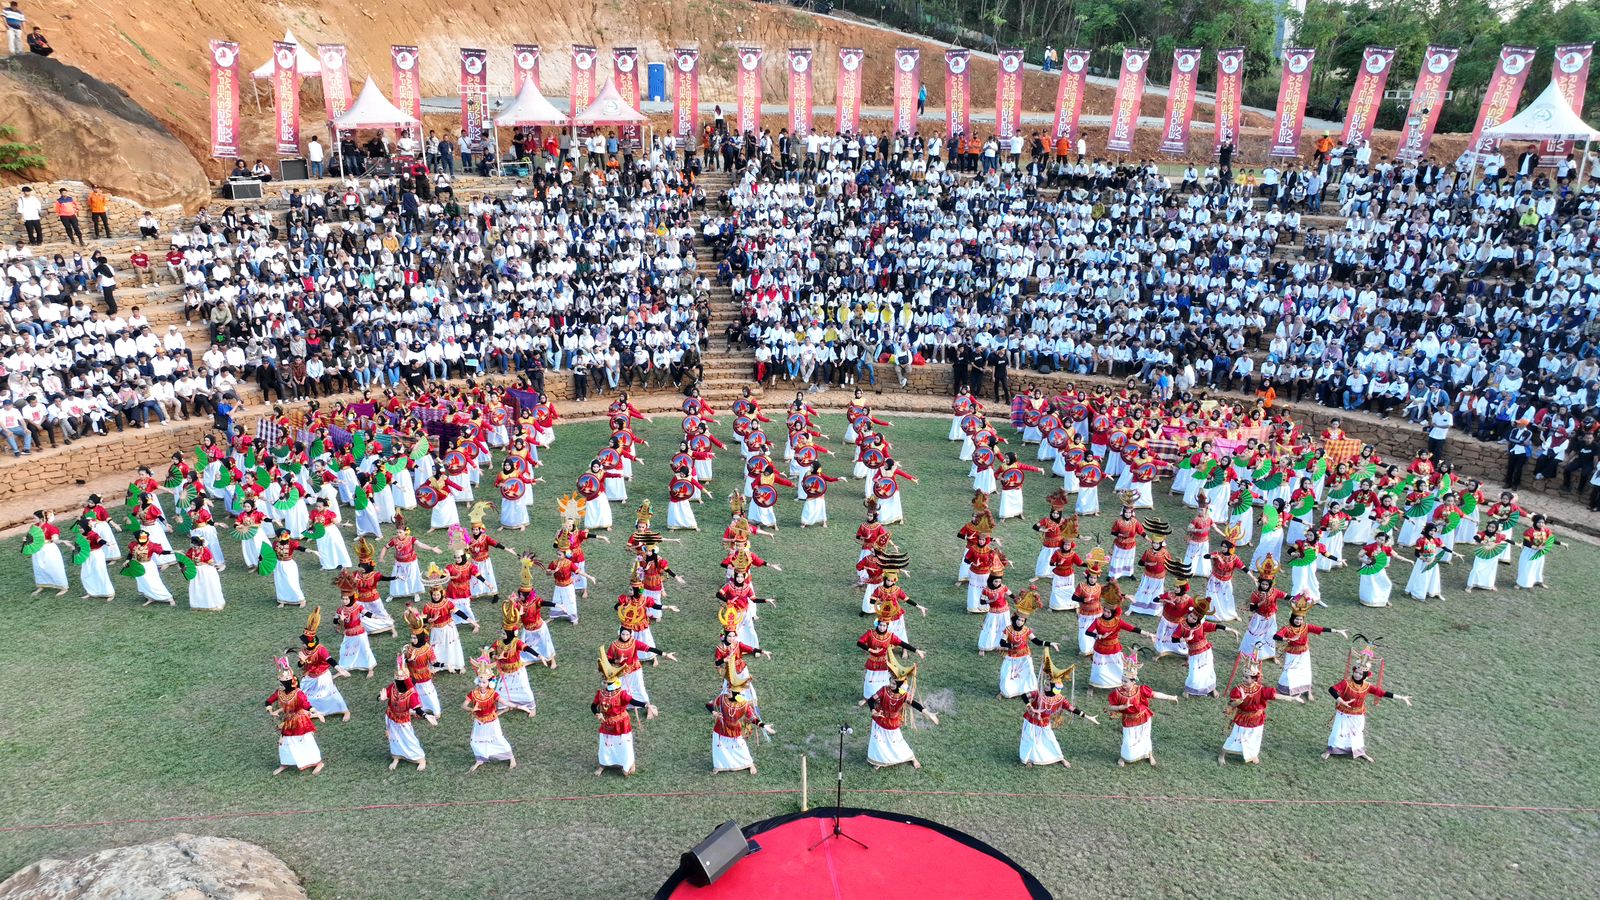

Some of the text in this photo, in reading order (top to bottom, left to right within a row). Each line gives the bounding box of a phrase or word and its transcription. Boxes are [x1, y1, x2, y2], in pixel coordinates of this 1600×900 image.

[216, 69, 226, 142] APEKSI 2023
[224, 69, 232, 126] RAKERNAS
[1008, 74, 1016, 123] RAKERNAS
[1067, 74, 1080, 123] RAKERNAS
[1126, 74, 1138, 123] RAKERNAS
[1173, 74, 1184, 111] APEKSI
[1178, 74, 1190, 124] RAKERNAS
[1228, 75, 1236, 127] RAKERNAS
[1283, 75, 1295, 114] APEKSI
[1288, 75, 1303, 127] RAKERNAS
[1355, 76, 1371, 115] APEKSI
[1358, 76, 1379, 130] RAKERNAS
[1492, 76, 1516, 127] RAKERNA
[1168, 111, 1178, 138] 2023
[1278, 114, 1290, 144] 2023
